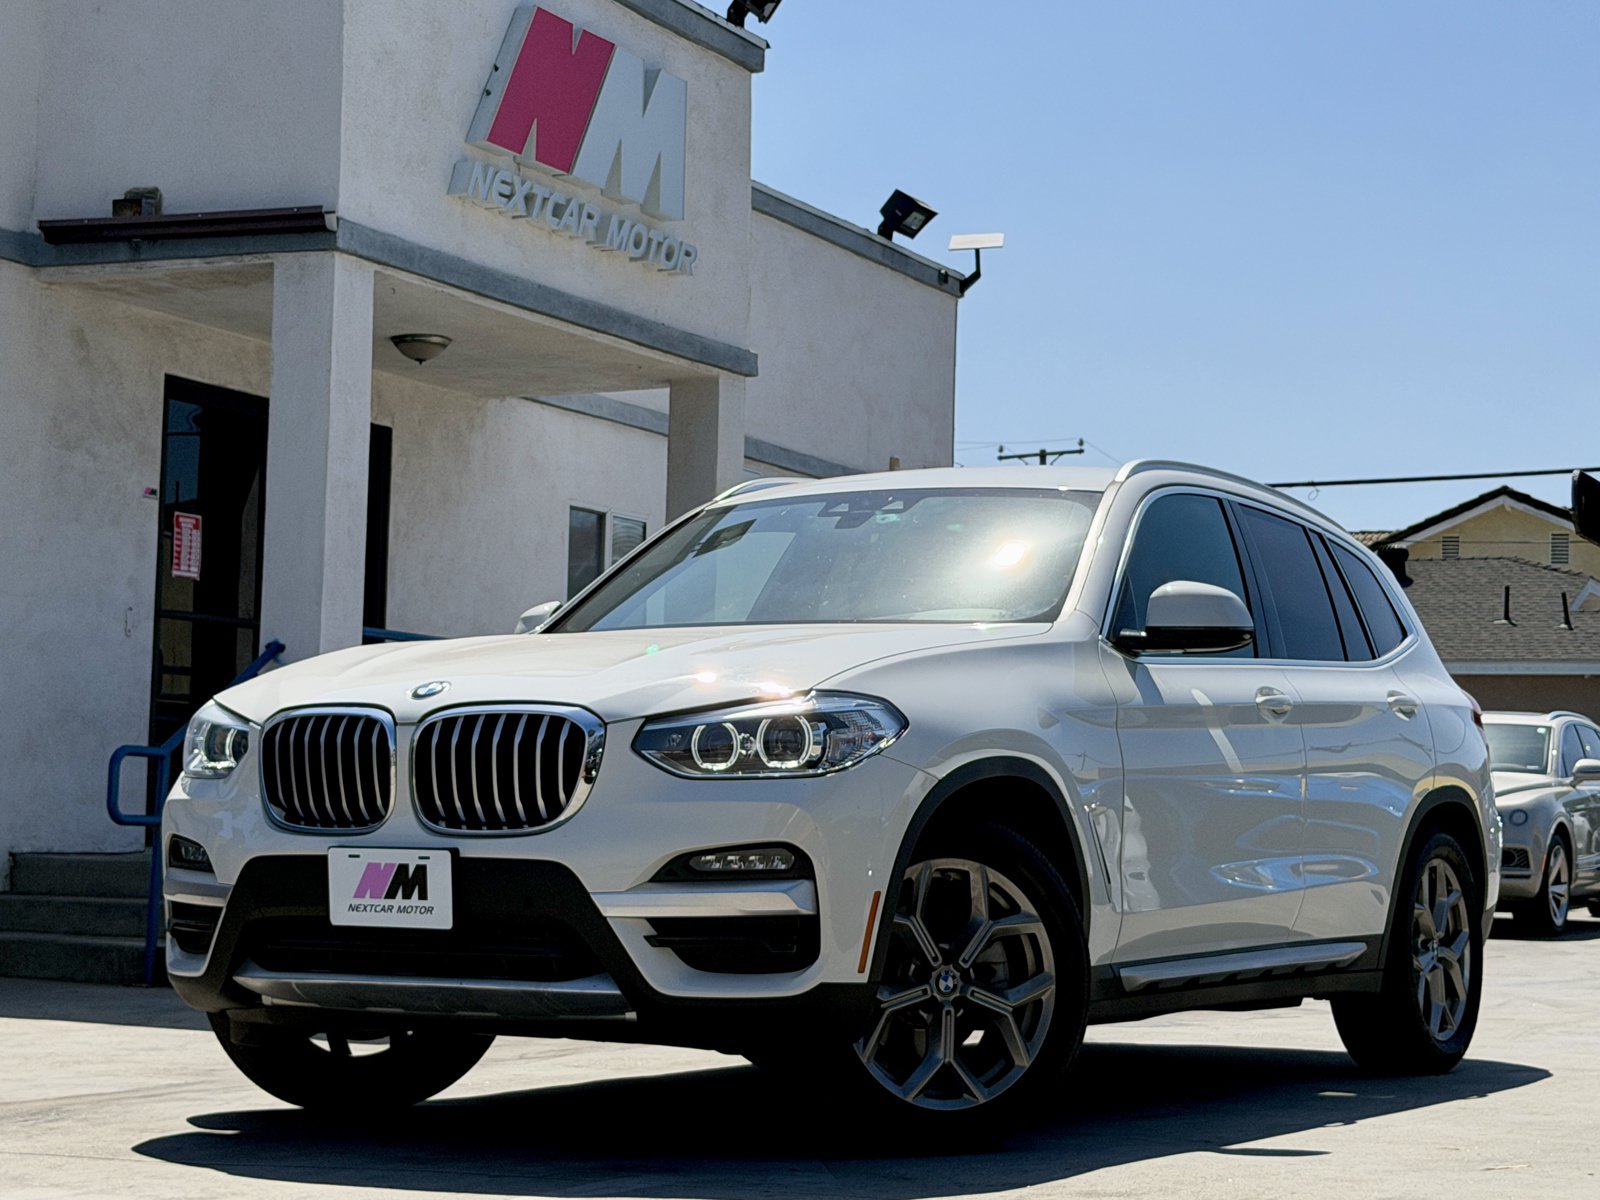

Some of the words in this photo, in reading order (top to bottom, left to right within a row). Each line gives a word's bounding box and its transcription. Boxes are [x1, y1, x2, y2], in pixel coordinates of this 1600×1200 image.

[486, 6, 687, 221] NM
[467, 161, 600, 242] NEXTCAR
[606, 215, 697, 274] MOTOR
[347, 903, 394, 914] NEXTCAR
[396, 904, 434, 915] MOTOR
[353, 862, 428, 900] NM
